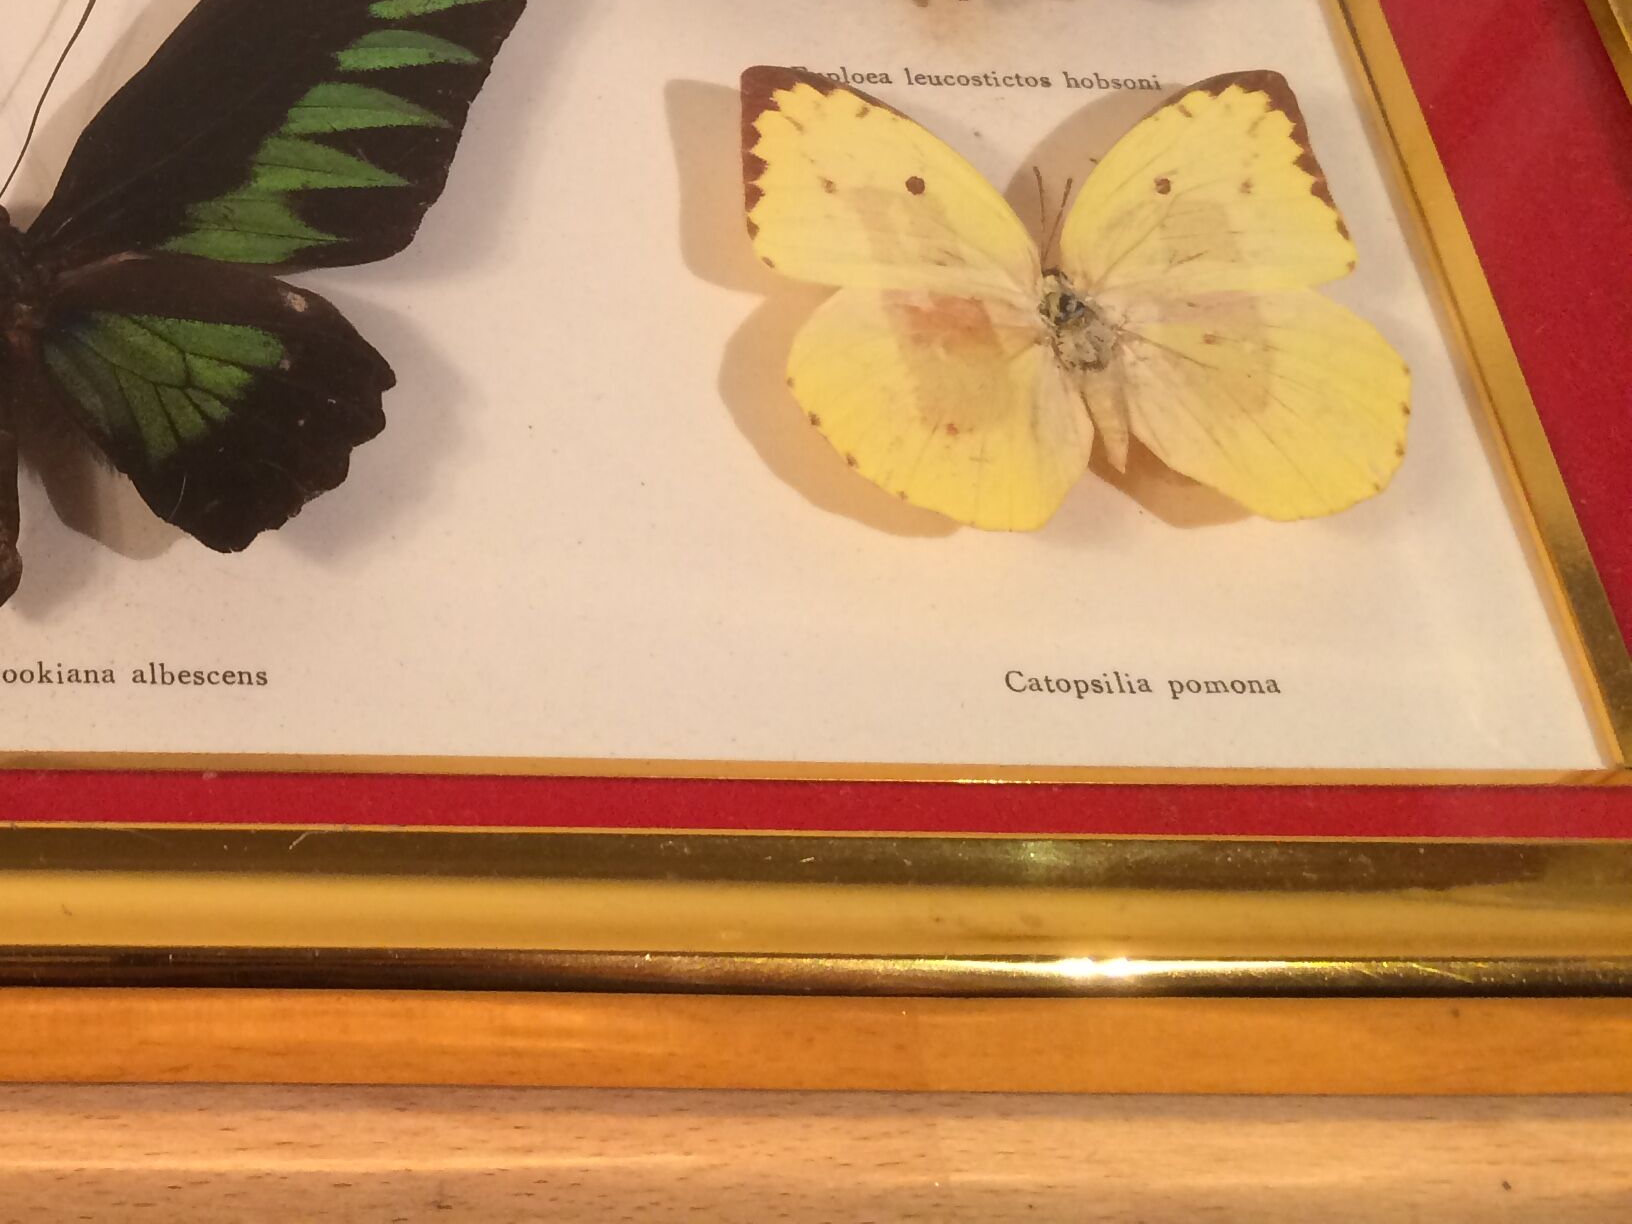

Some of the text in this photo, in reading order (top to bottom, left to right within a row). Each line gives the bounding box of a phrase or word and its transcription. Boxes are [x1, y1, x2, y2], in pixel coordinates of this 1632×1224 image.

[789, 65, 1162, 91] ploea leucostictos hobsoni
[131, 662, 269, 686] albescens
[1004, 670, 1282, 699] Catopsilia pomona
